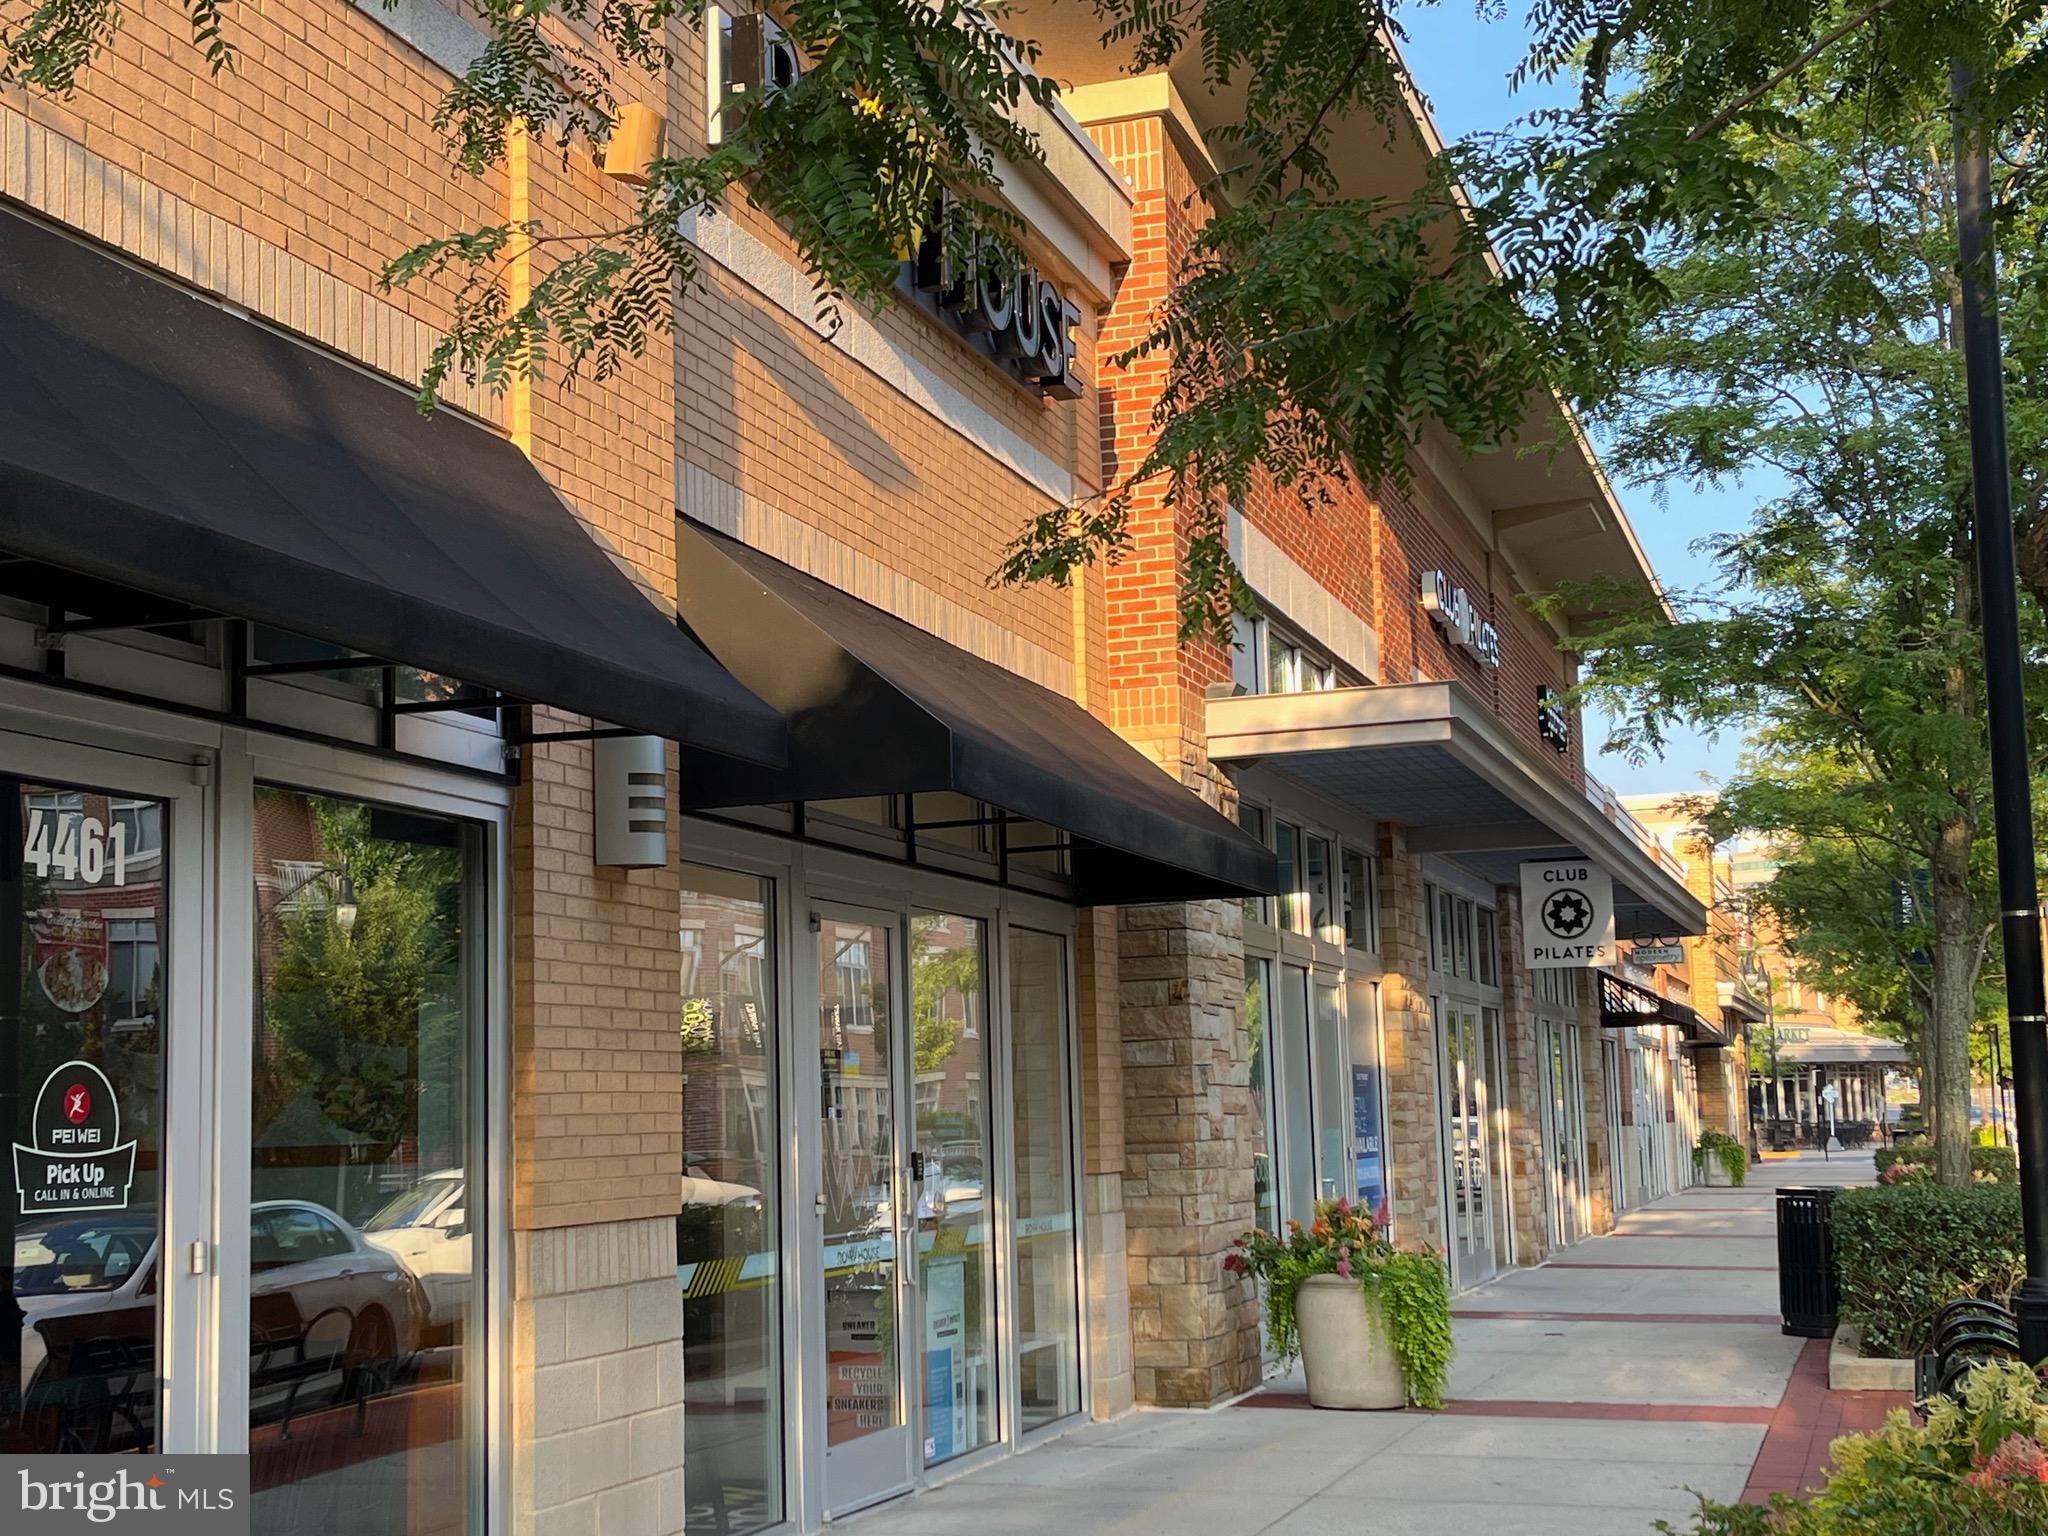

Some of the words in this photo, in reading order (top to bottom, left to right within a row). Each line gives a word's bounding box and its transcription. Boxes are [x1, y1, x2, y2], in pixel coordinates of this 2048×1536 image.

[24, 809, 125, 886] 4461
[1543, 868, 1588, 882] CLUB
[1534, 945, 1606, 960] PILATES
[1774, 1026, 1811, 1042] ARKET
[52, 1128, 75, 1144] PEI
[77, 1128, 101, 1143] WEI
[46, 1163, 80, 1185] Pick
[82, 1163, 105, 1186] Up
[34, 1188, 58, 1202] CALL
[60, 1188, 70, 1200] IN
[72, 1188, 79, 1200] &
[81, 1186, 116, 1199] ONLINE
[841, 1367, 882, 1379] RECYCLE
[856, 1383, 883, 1395] YOUR
[834, 1399, 884, 1411] SNEAKERS
